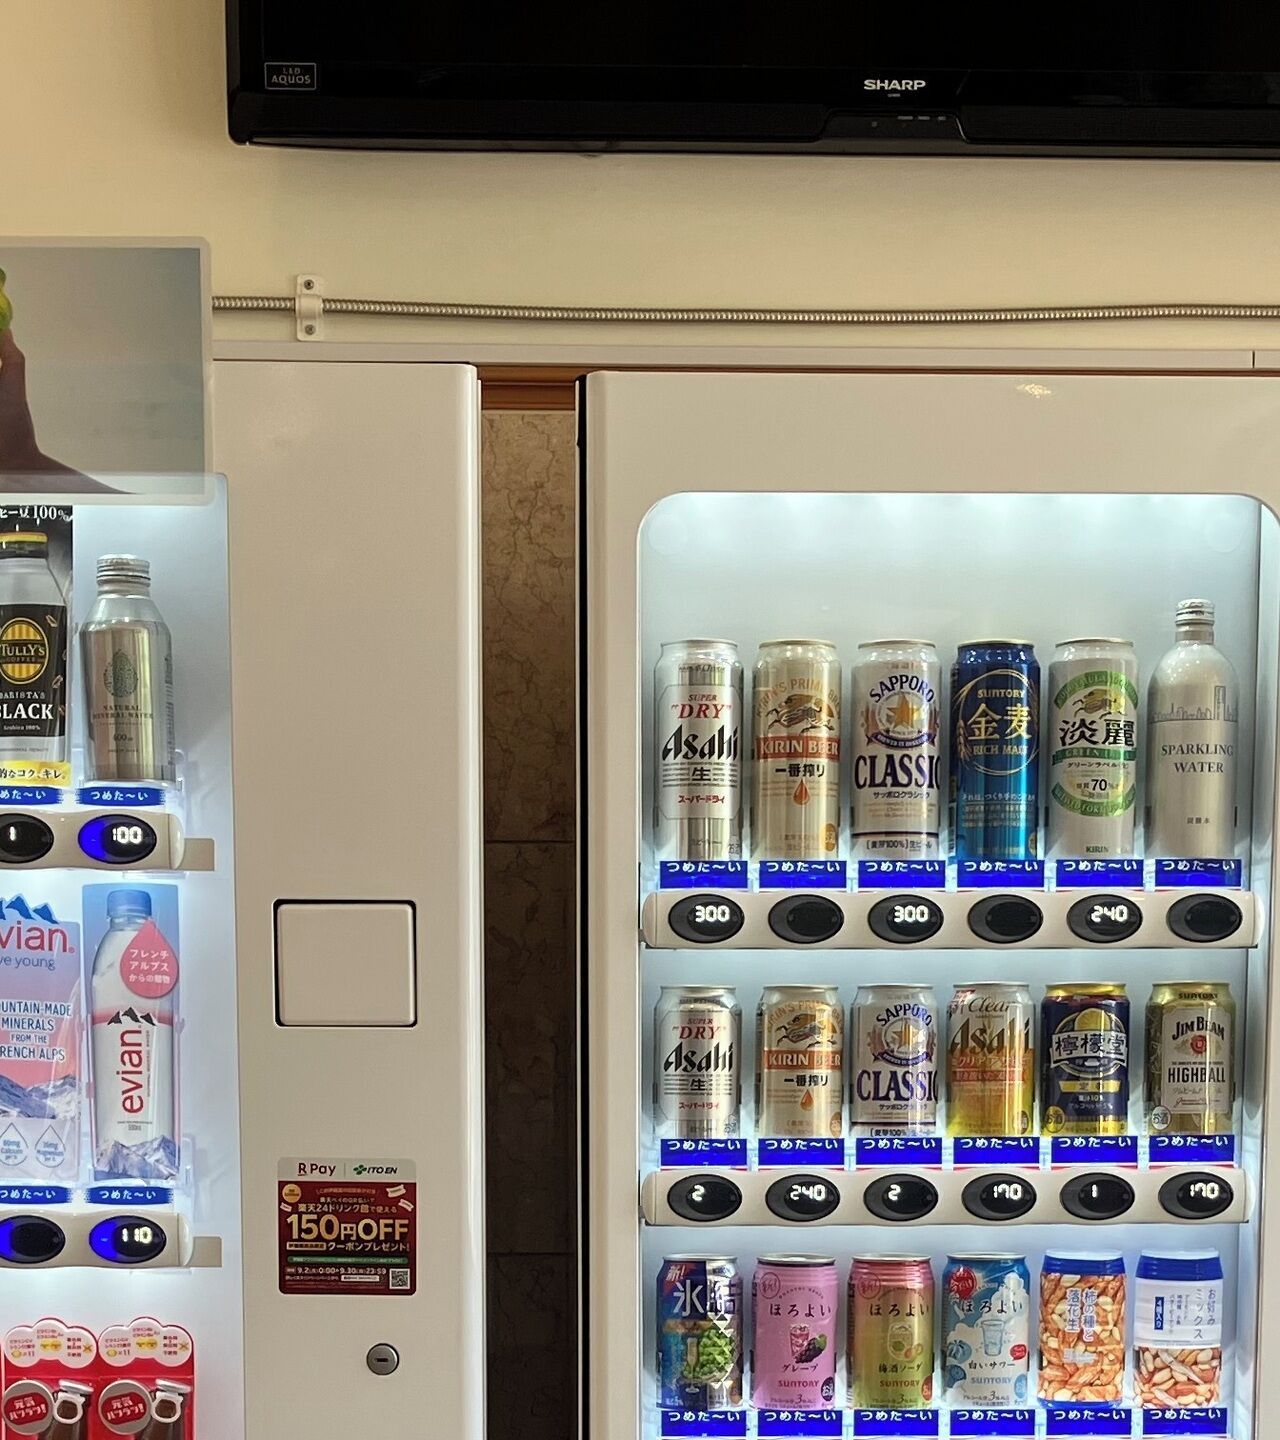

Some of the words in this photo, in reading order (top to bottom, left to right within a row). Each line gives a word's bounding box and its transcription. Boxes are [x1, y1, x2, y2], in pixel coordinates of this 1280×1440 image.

[271, 74, 311, 86] AQUOS
[864, 79, 926, 91] SHARP
[0, 642, 47, 659] TULLY'S
[869, 673, 935, 704] SAPPORO
[967, 703, 1033, 741] 金麦
[1059, 717, 1136, 748] 淡麗
[662, 723, 739, 761] Asahi
[760, 739, 804, 755] KIRIN
[807, 740, 839, 756] BEER
[1161, 743, 1234, 757] SPARKLING
[691, 766, 712, 782] 生
[774, 763, 826, 778] 一番搾り
[1173, 761, 1225, 774] WATER
[111, 826, 144, 844] 100
[694, 905, 730, 923] 300
[893, 905, 929, 923] 300
[1091, 905, 1128, 923] 240
[129, 947, 169, 960] フレンチ
[14, 955, 56, 970] young
[129, 960, 170, 973] アルプス
[876, 1002, 933, 1027] SAPPORO
[1, 1017, 55, 1032] MINERALS
[1054, 1032, 1126, 1056] 檸檬堂
[37, 1047, 66, 1062] ALPS
[663, 1042, 734, 1074] Asahi
[115, 1028, 144, 1115] evian
[1168, 1067, 1226, 1084] HIGHBALL
[783, 1074, 830, 1087] 一番搾り
[789, 1184, 826, 1201] 240
[286, 1213, 410, 1241] 150円OFF
[769, 1303, 832, 1318] ほろよい
[869, 1303, 930, 1317] ほろよい
[960, 1300, 1023, 1314] ほろよい
[1066, 1288, 1080, 1333] 落花生
[1081, 1288, 1098, 1343] 柿の種と
[967, 1360, 1016, 1371] 白いサワー
